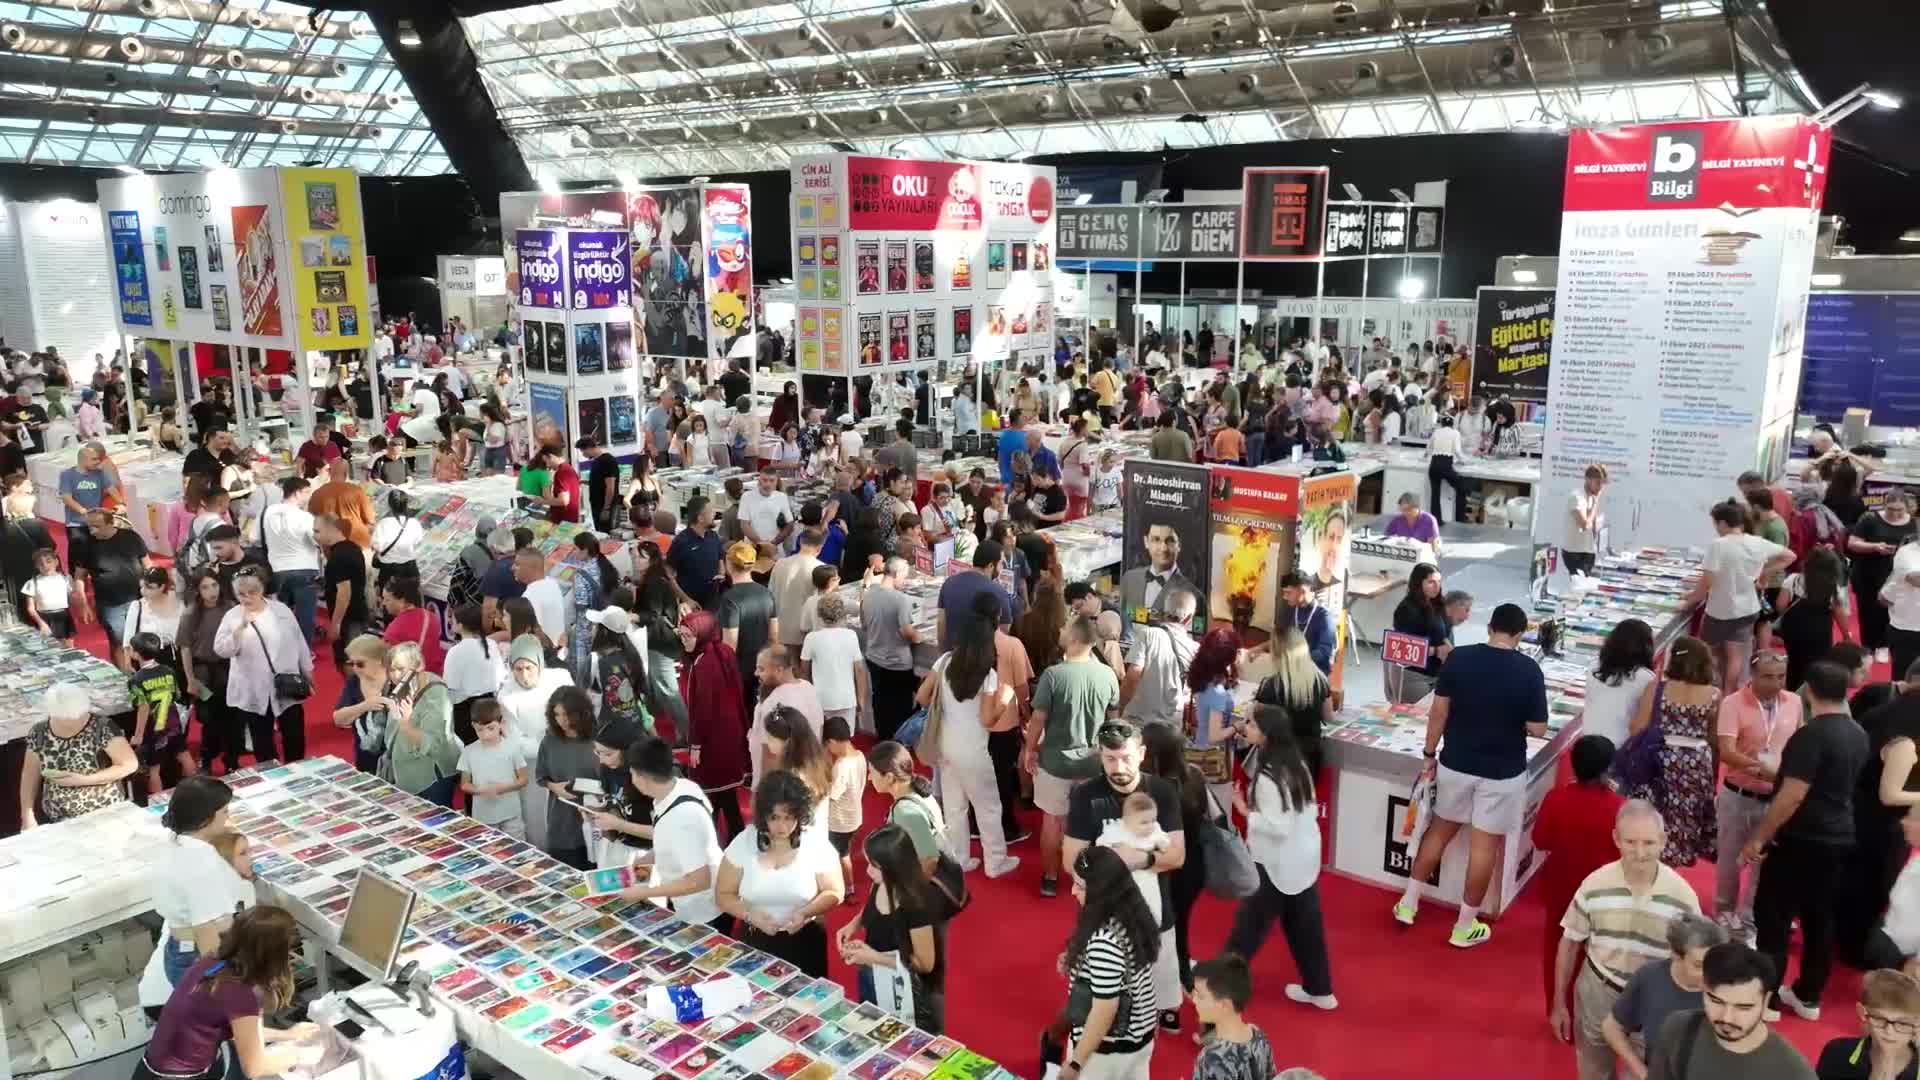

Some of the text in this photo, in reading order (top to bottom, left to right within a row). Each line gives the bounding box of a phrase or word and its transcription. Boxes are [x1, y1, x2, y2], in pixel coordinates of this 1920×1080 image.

[1650, 180, 1694, 199] Bilgi
[160, 189, 212, 219] domingo
[1192, 211, 1236, 228] CARPE
[521, 258, 559, 284] indigo
[574, 260, 624, 283] indigo
[1491, 320, 1537, 349] Eğitici
[1498, 352, 1548, 373] Markası
[1133, 473, 1146, 485] Dr.
[1405, 644, 1420, 662] 30
[150, 690, 173, 731] 7
